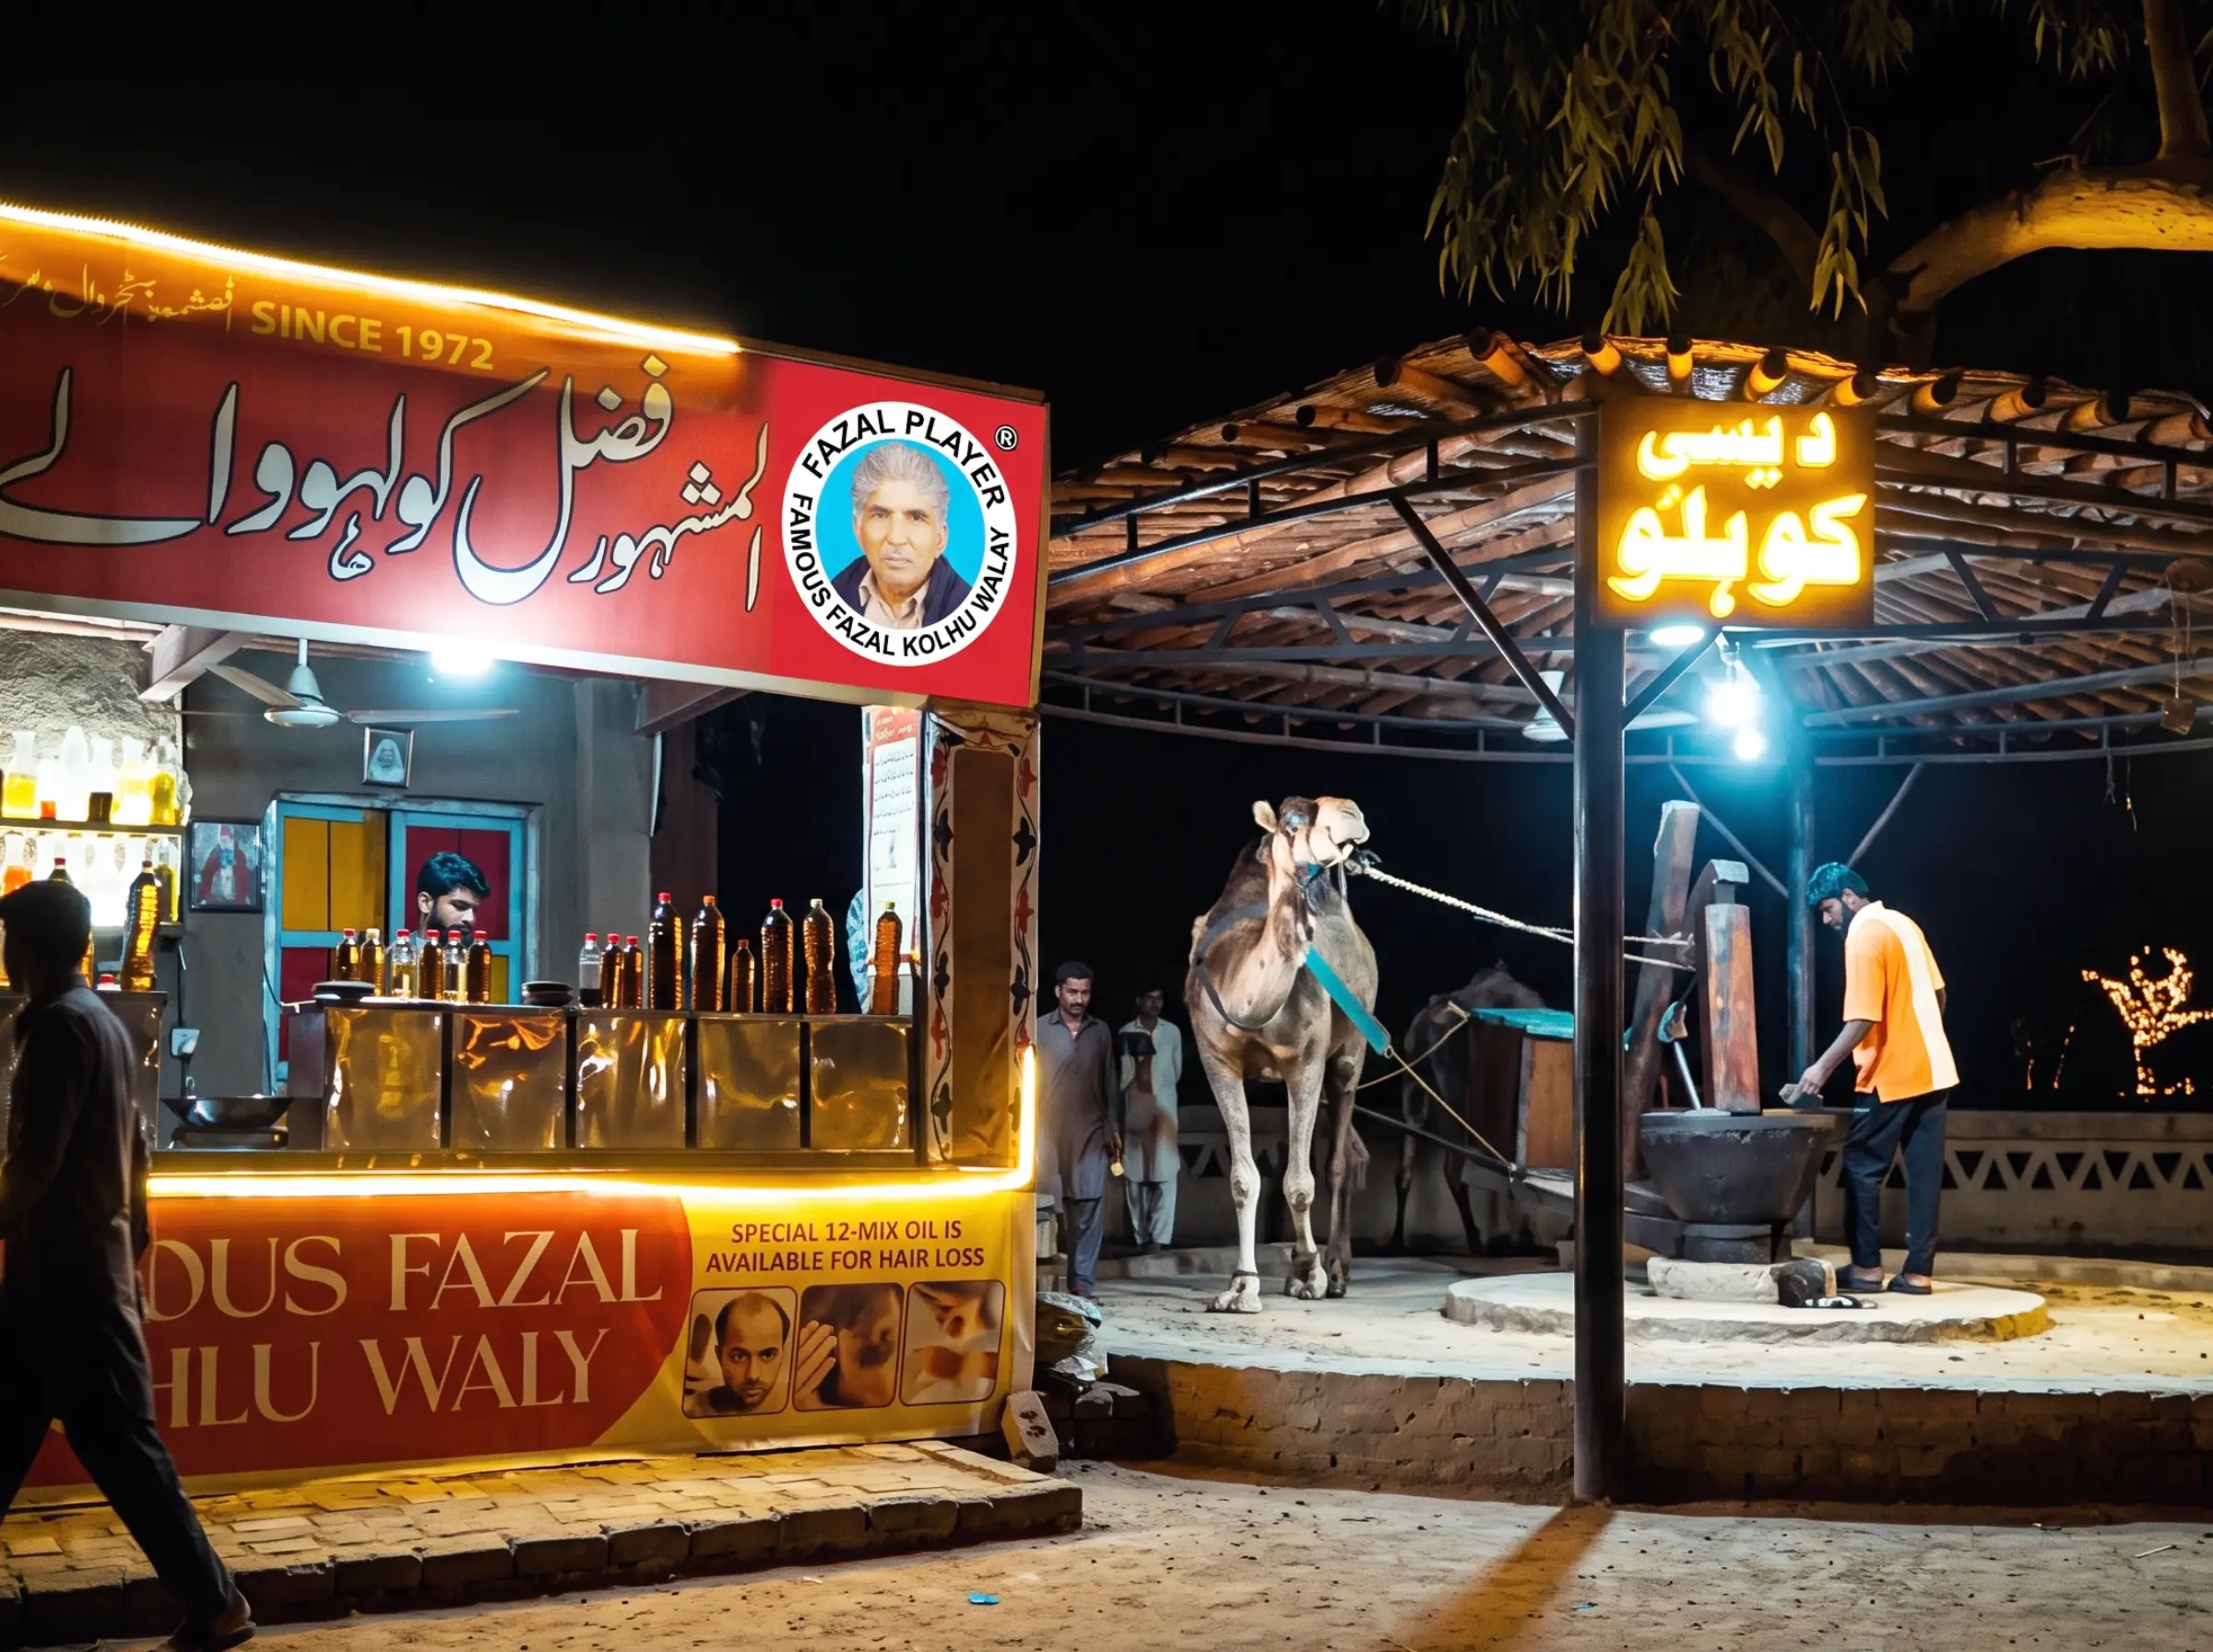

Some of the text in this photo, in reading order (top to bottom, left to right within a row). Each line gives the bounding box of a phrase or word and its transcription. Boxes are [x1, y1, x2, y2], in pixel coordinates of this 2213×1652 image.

[251, 301, 494, 371] SINCE 1972
[453, 354, 673, 606] فضل
[801, 408, 1006, 510] FAZAL PLAYER
[789, 492, 1011, 657] FAMOUS FAZAL KOLHU WALAY
[147, 1228, 664, 1322] OUS FAZAL
[705, 1247, 986, 1273] AVAILABLE FOR HAIR LOSS
[730, 1220, 962, 1244] SPECIAL 12-MIX OIL IS
[152, 1328, 610, 1428] HLU WALY
